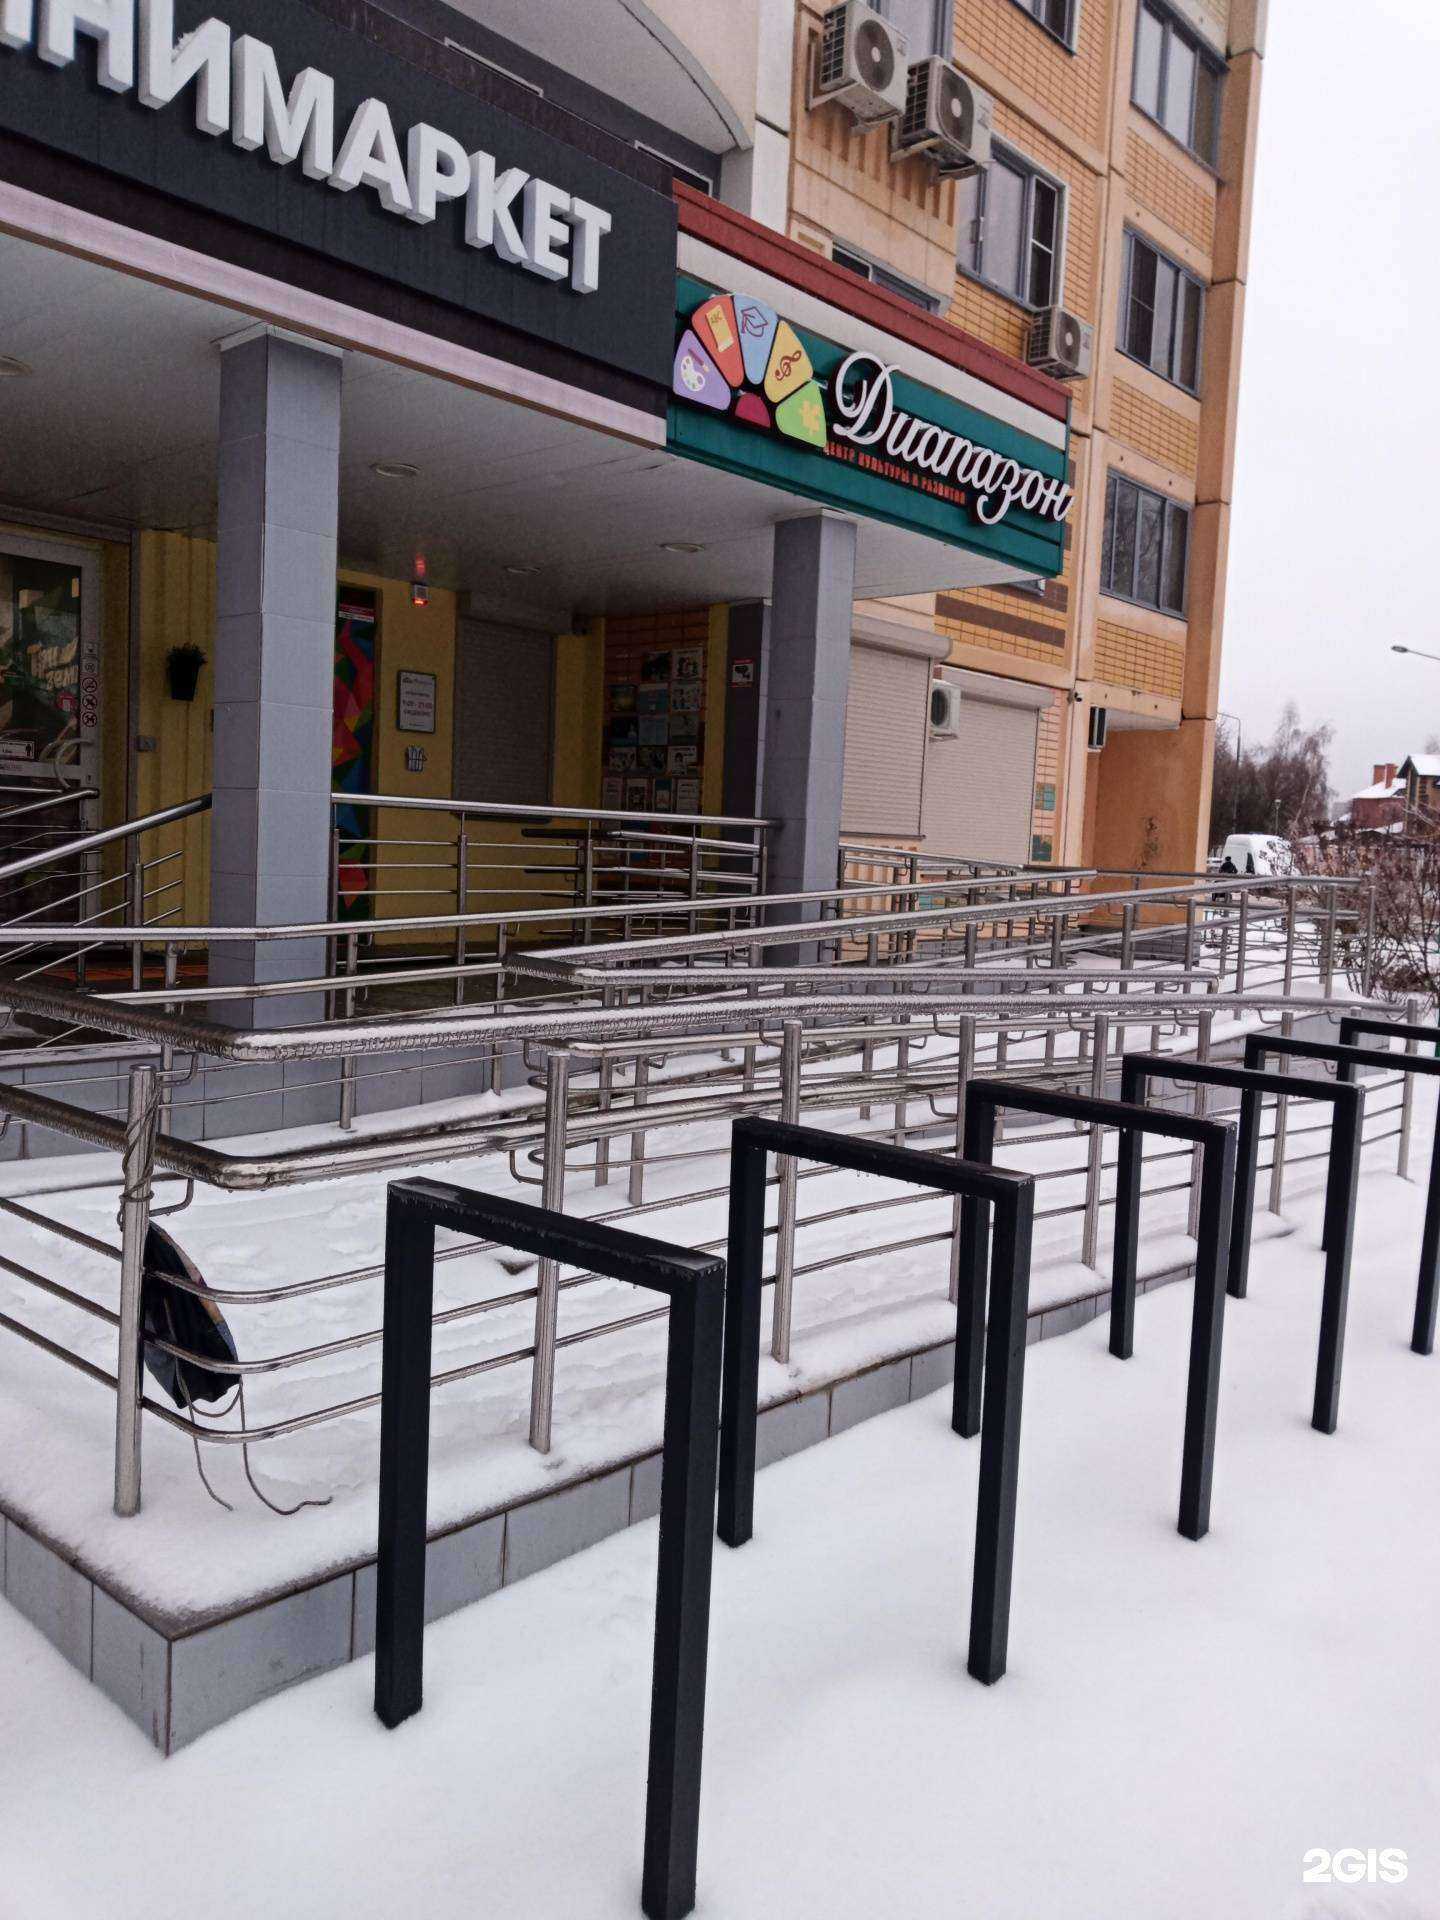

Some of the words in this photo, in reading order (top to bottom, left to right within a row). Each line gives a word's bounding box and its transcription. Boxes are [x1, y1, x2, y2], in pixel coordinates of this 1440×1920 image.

[0, 0, 612, 294] НИМАРКЕТ
[823, 442, 856, 463] ЦЕНТР
[857, 451, 910, 483] КУЛЬТУРЫ
[912, 475, 919, 487] И
[921, 478, 966, 505] РАЗВИТИЯ
[833, 350, 1075, 526] Диапазон
